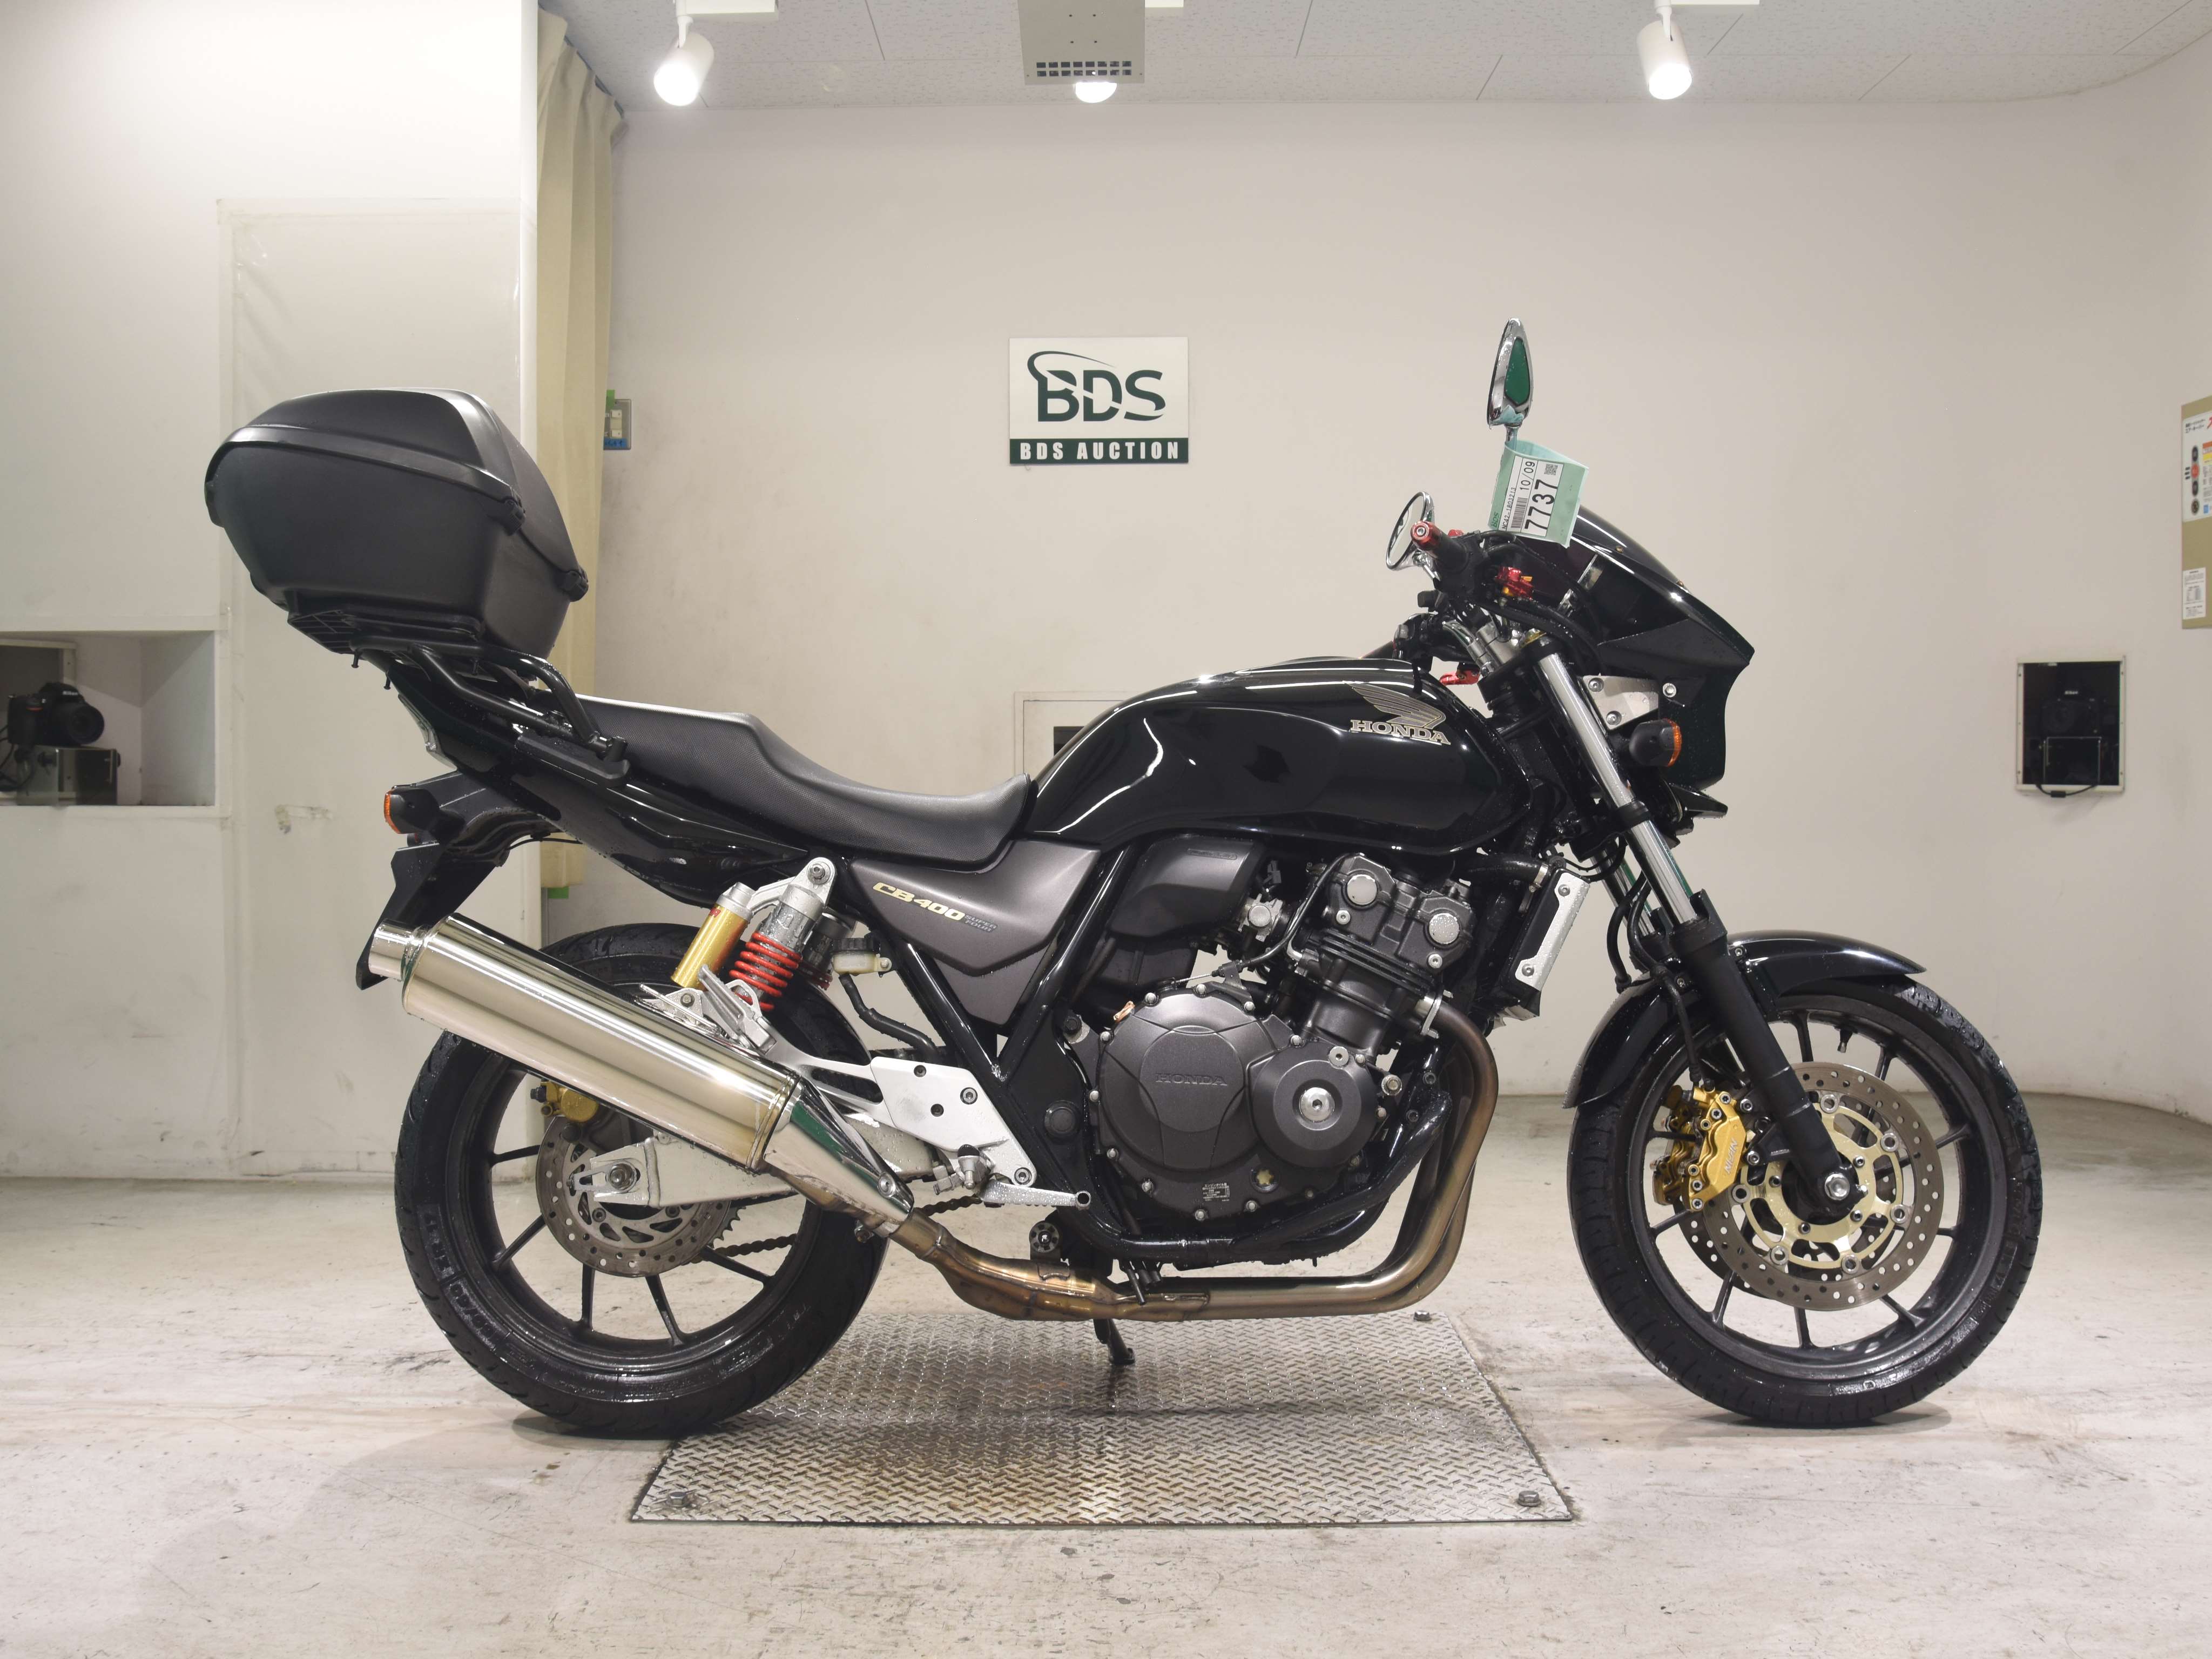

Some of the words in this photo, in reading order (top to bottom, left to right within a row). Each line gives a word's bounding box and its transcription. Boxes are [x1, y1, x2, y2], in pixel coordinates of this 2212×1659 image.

[1027, 350, 1166, 422] BDS
[1020, 443, 1063, 460] BDS
[1077, 441, 1178, 460] AUCTION
[1520, 461, 1535, 490] 10/09
[1525, 479, 1558, 530] 7737
[1350, 720, 1451, 745] HONDA
[965, 915, 997, 929] SUPER
[1155, 1073, 1228, 1086] HONDA
